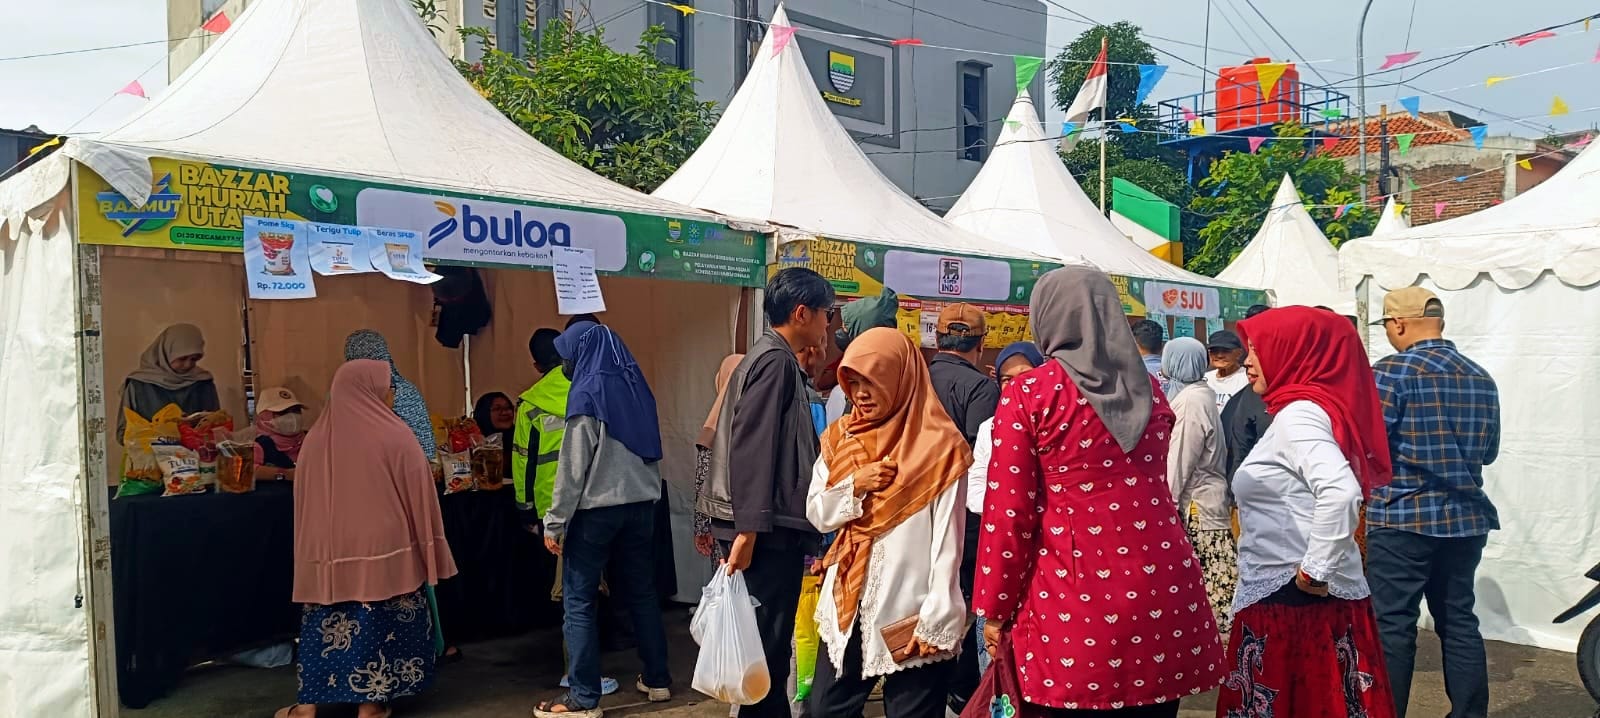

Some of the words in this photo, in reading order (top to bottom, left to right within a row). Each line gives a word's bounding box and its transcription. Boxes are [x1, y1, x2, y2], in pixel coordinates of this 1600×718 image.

[180, 164, 291, 194] BAZZAR
[188, 185, 286, 213] MURAH
[280, 220, 295, 230] 5kg
[315, 225, 341, 234] Terigu
[342, 228, 361, 236] Tulip
[810, 239, 856, 256] BAZZAR
[813, 251, 855, 268] MURAH
[256, 282, 271, 290] Rp.
[272, 281, 306, 290] 72.000
[1181, 290, 1203, 310] SJU
